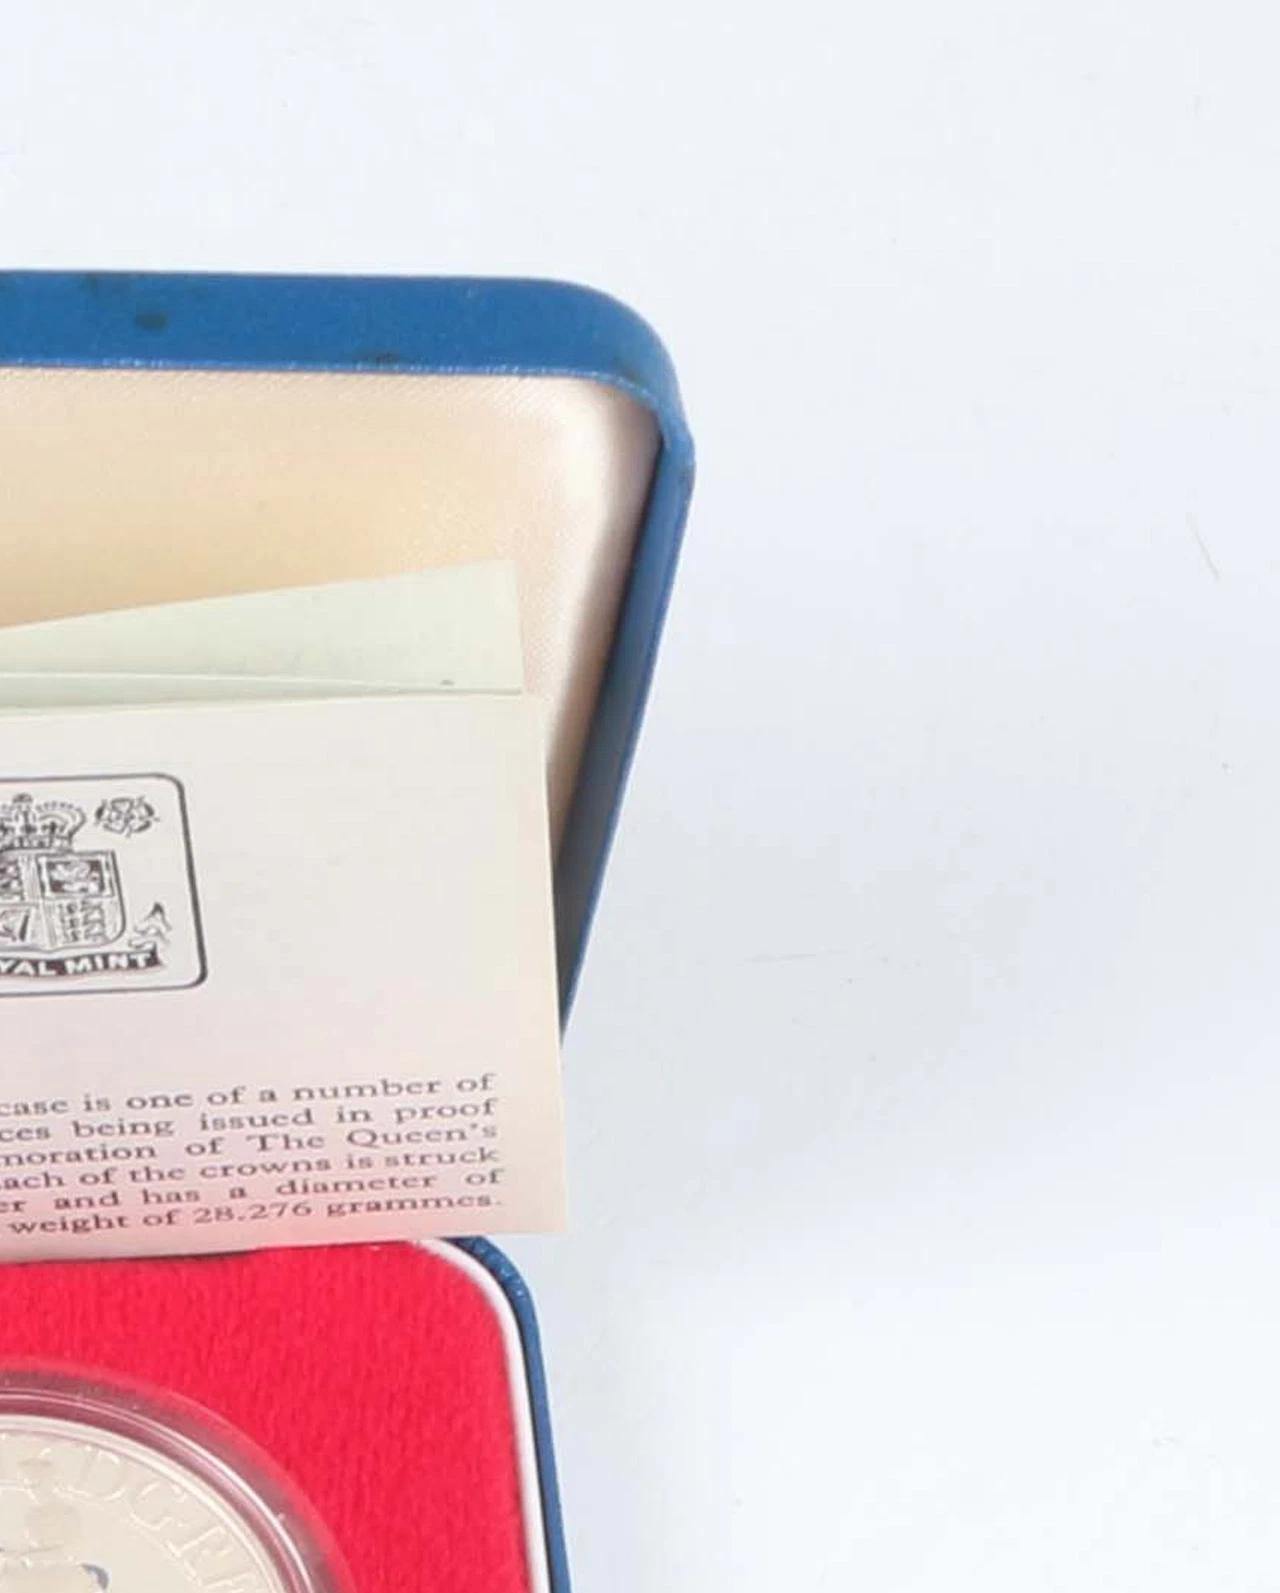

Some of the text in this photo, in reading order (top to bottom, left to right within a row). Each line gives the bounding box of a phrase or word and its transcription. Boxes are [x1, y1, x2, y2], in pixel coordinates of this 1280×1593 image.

[66, 951, 152, 976] MINT
[82, 1093, 111, 1112] is
[125, 1091, 194, 1110] one
[207, 1086, 246, 1104] of
[258, 1087, 277, 1103] a
[293, 1078, 441, 1101] number
[456, 1074, 495, 1093] of
[73, 1118, 175, 1137] being
[199, 1108, 314, 1131] issued
[336, 1105, 372, 1124] in
[393, 1098, 497, 1124] proof
[185, 1137, 225, 1157] of
[246, 1133, 326, 1153] The
[346, 1122, 498, 1148] Queen's
[80, 1168, 119, 1185] of
[129, 1162, 186, 1182] the
[199, 1157, 331, 1179] crowns
[346, 1151, 373, 1169] is
[385, 1147, 500, 1167] struck
[53, 1190, 119, 1208] and
[142, 1185, 200, 1205] has
[228, 1185, 247, 1199] a
[275, 1172, 437, 1196] diameter
[465, 1169, 504, 1187] of
[8, 1213, 130, 1236] weight
[142, 1207, 177, 1227] of
[192, 1201, 312, 1223] 28.276
[326, 1194, 502, 1219] grammes.
